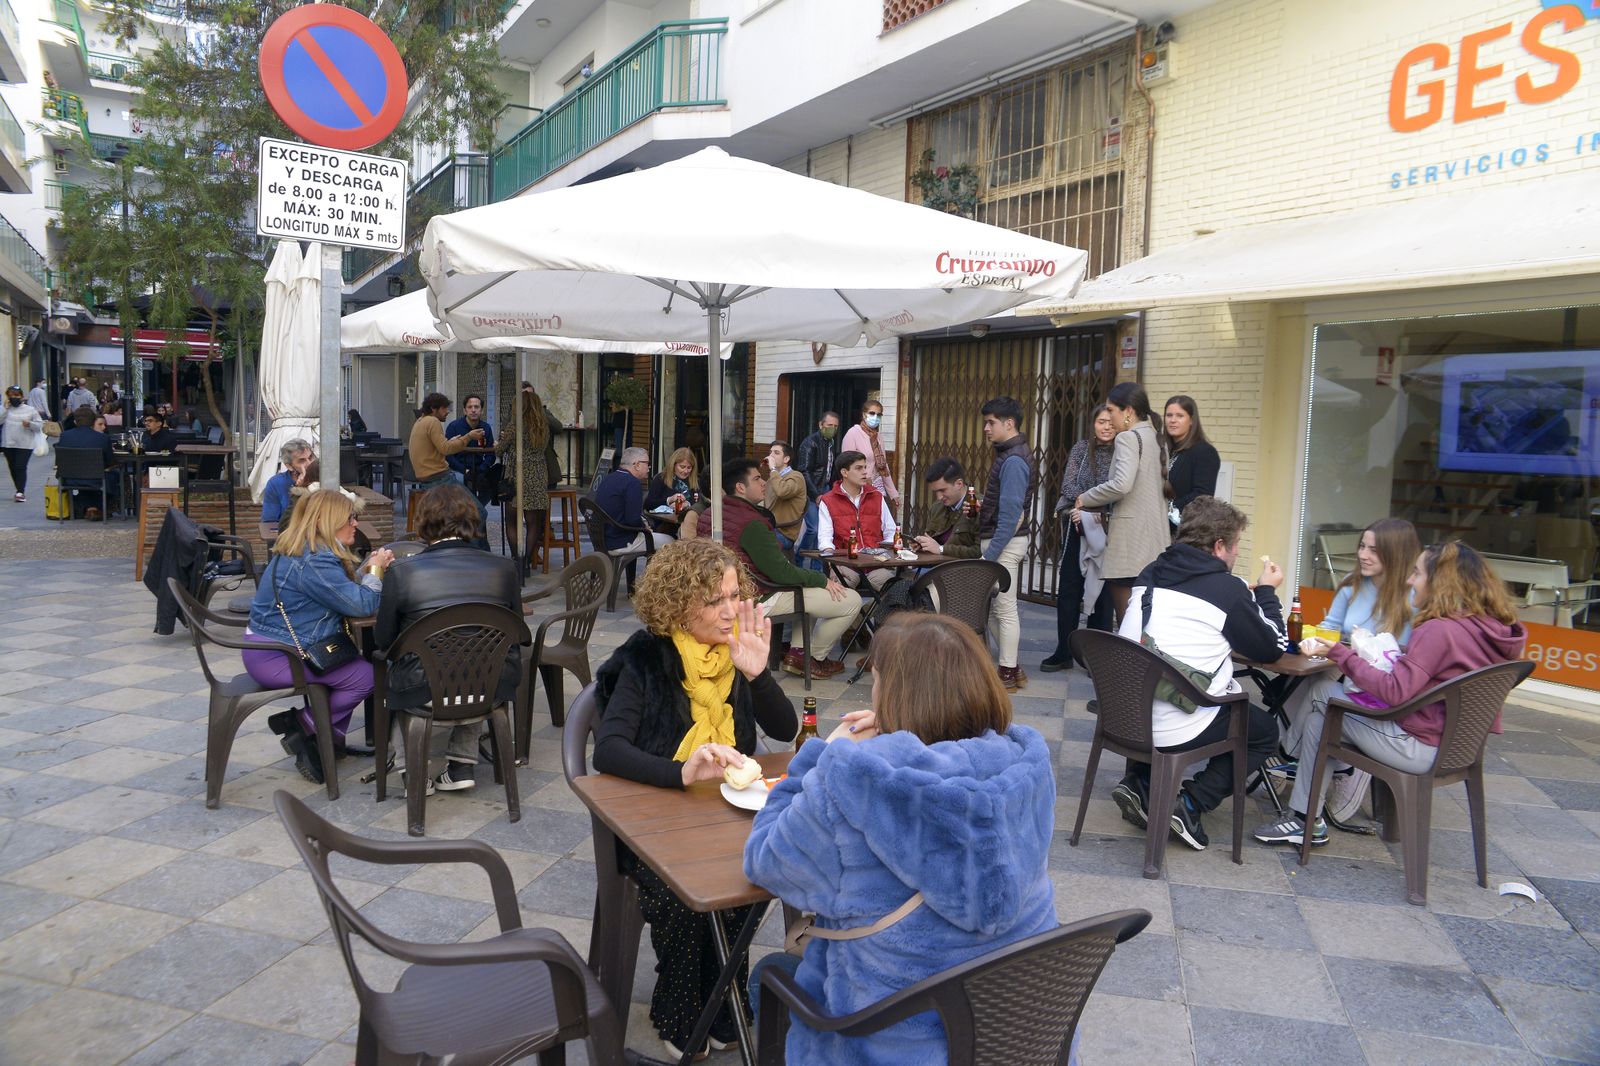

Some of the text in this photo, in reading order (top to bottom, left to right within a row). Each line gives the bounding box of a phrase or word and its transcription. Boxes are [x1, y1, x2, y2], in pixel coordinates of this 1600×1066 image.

[1388, 4, 1587, 133] GES
[269, 146, 399, 178] EXCEPTO CARGA
[1391, 143, 1549, 189] SERVICIOS
[285, 166, 383, 192] Y DESCARGA
[268, 182, 397, 210] de 8.00 a 12:00 h.
[284, 200, 382, 225] MÁX: 30 MIN.
[266, 216, 329, 235] LONGITUD
[366, 230, 373, 241] 5
[377, 232, 397, 244] mts
[936, 250, 1056, 277] Cruzcampo
